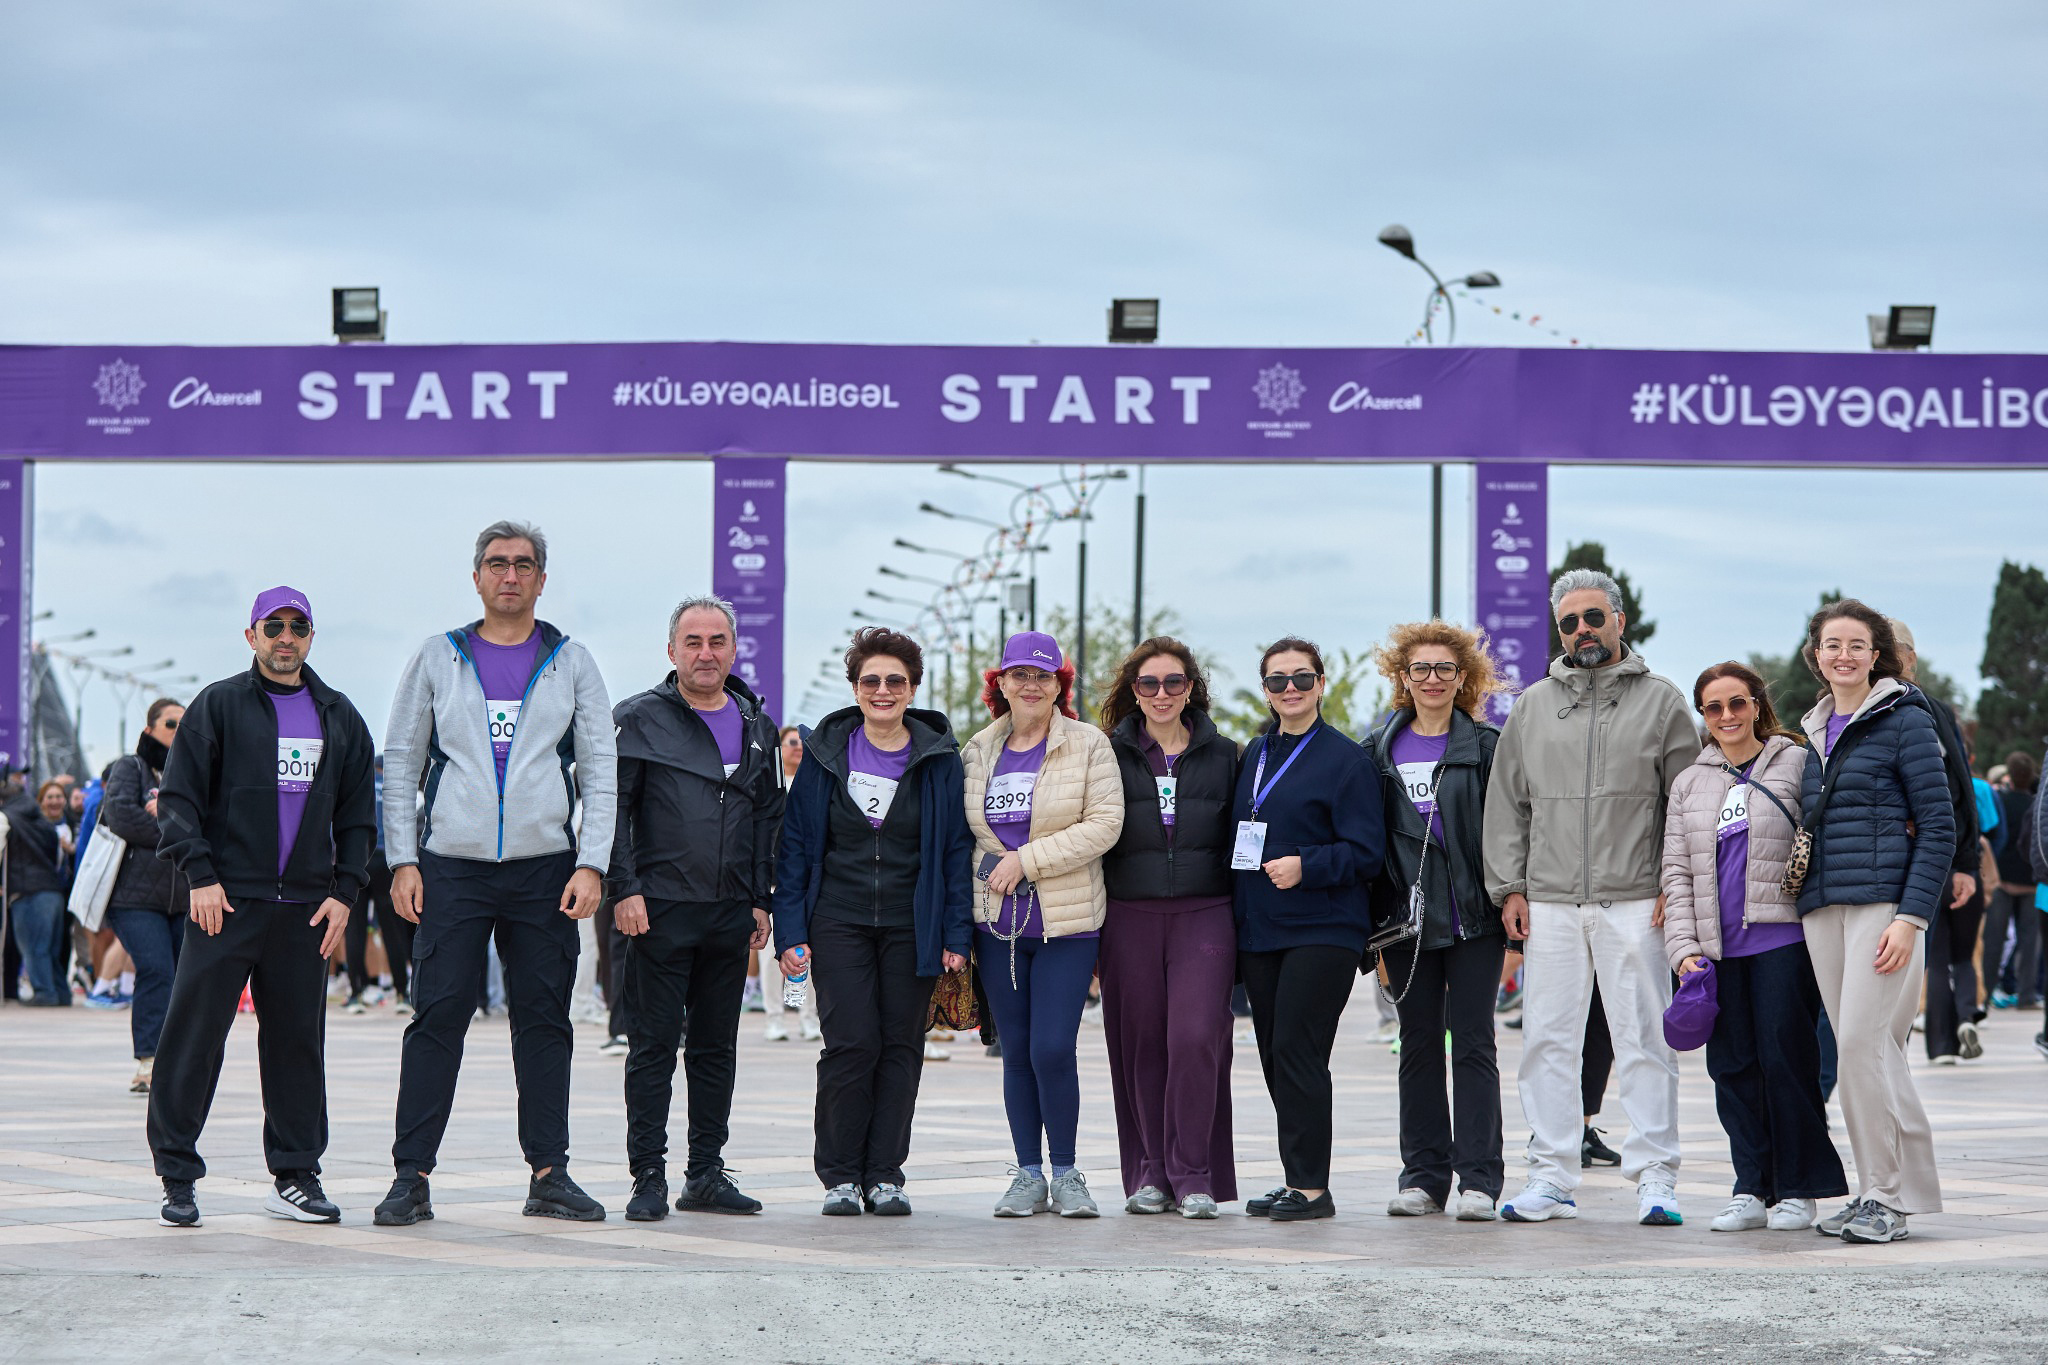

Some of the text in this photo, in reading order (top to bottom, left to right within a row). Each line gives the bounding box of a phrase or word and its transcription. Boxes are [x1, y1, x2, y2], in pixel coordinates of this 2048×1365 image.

[202, 389, 262, 406] Azercell
[297, 371, 569, 421] START
[612, 375, 900, 409] #KÜLƏYƏQALİBGƏL
[940, 374, 1211, 424] START
[1361, 394, 1423, 410] Azercell
[867, 797, 880, 814] 2
